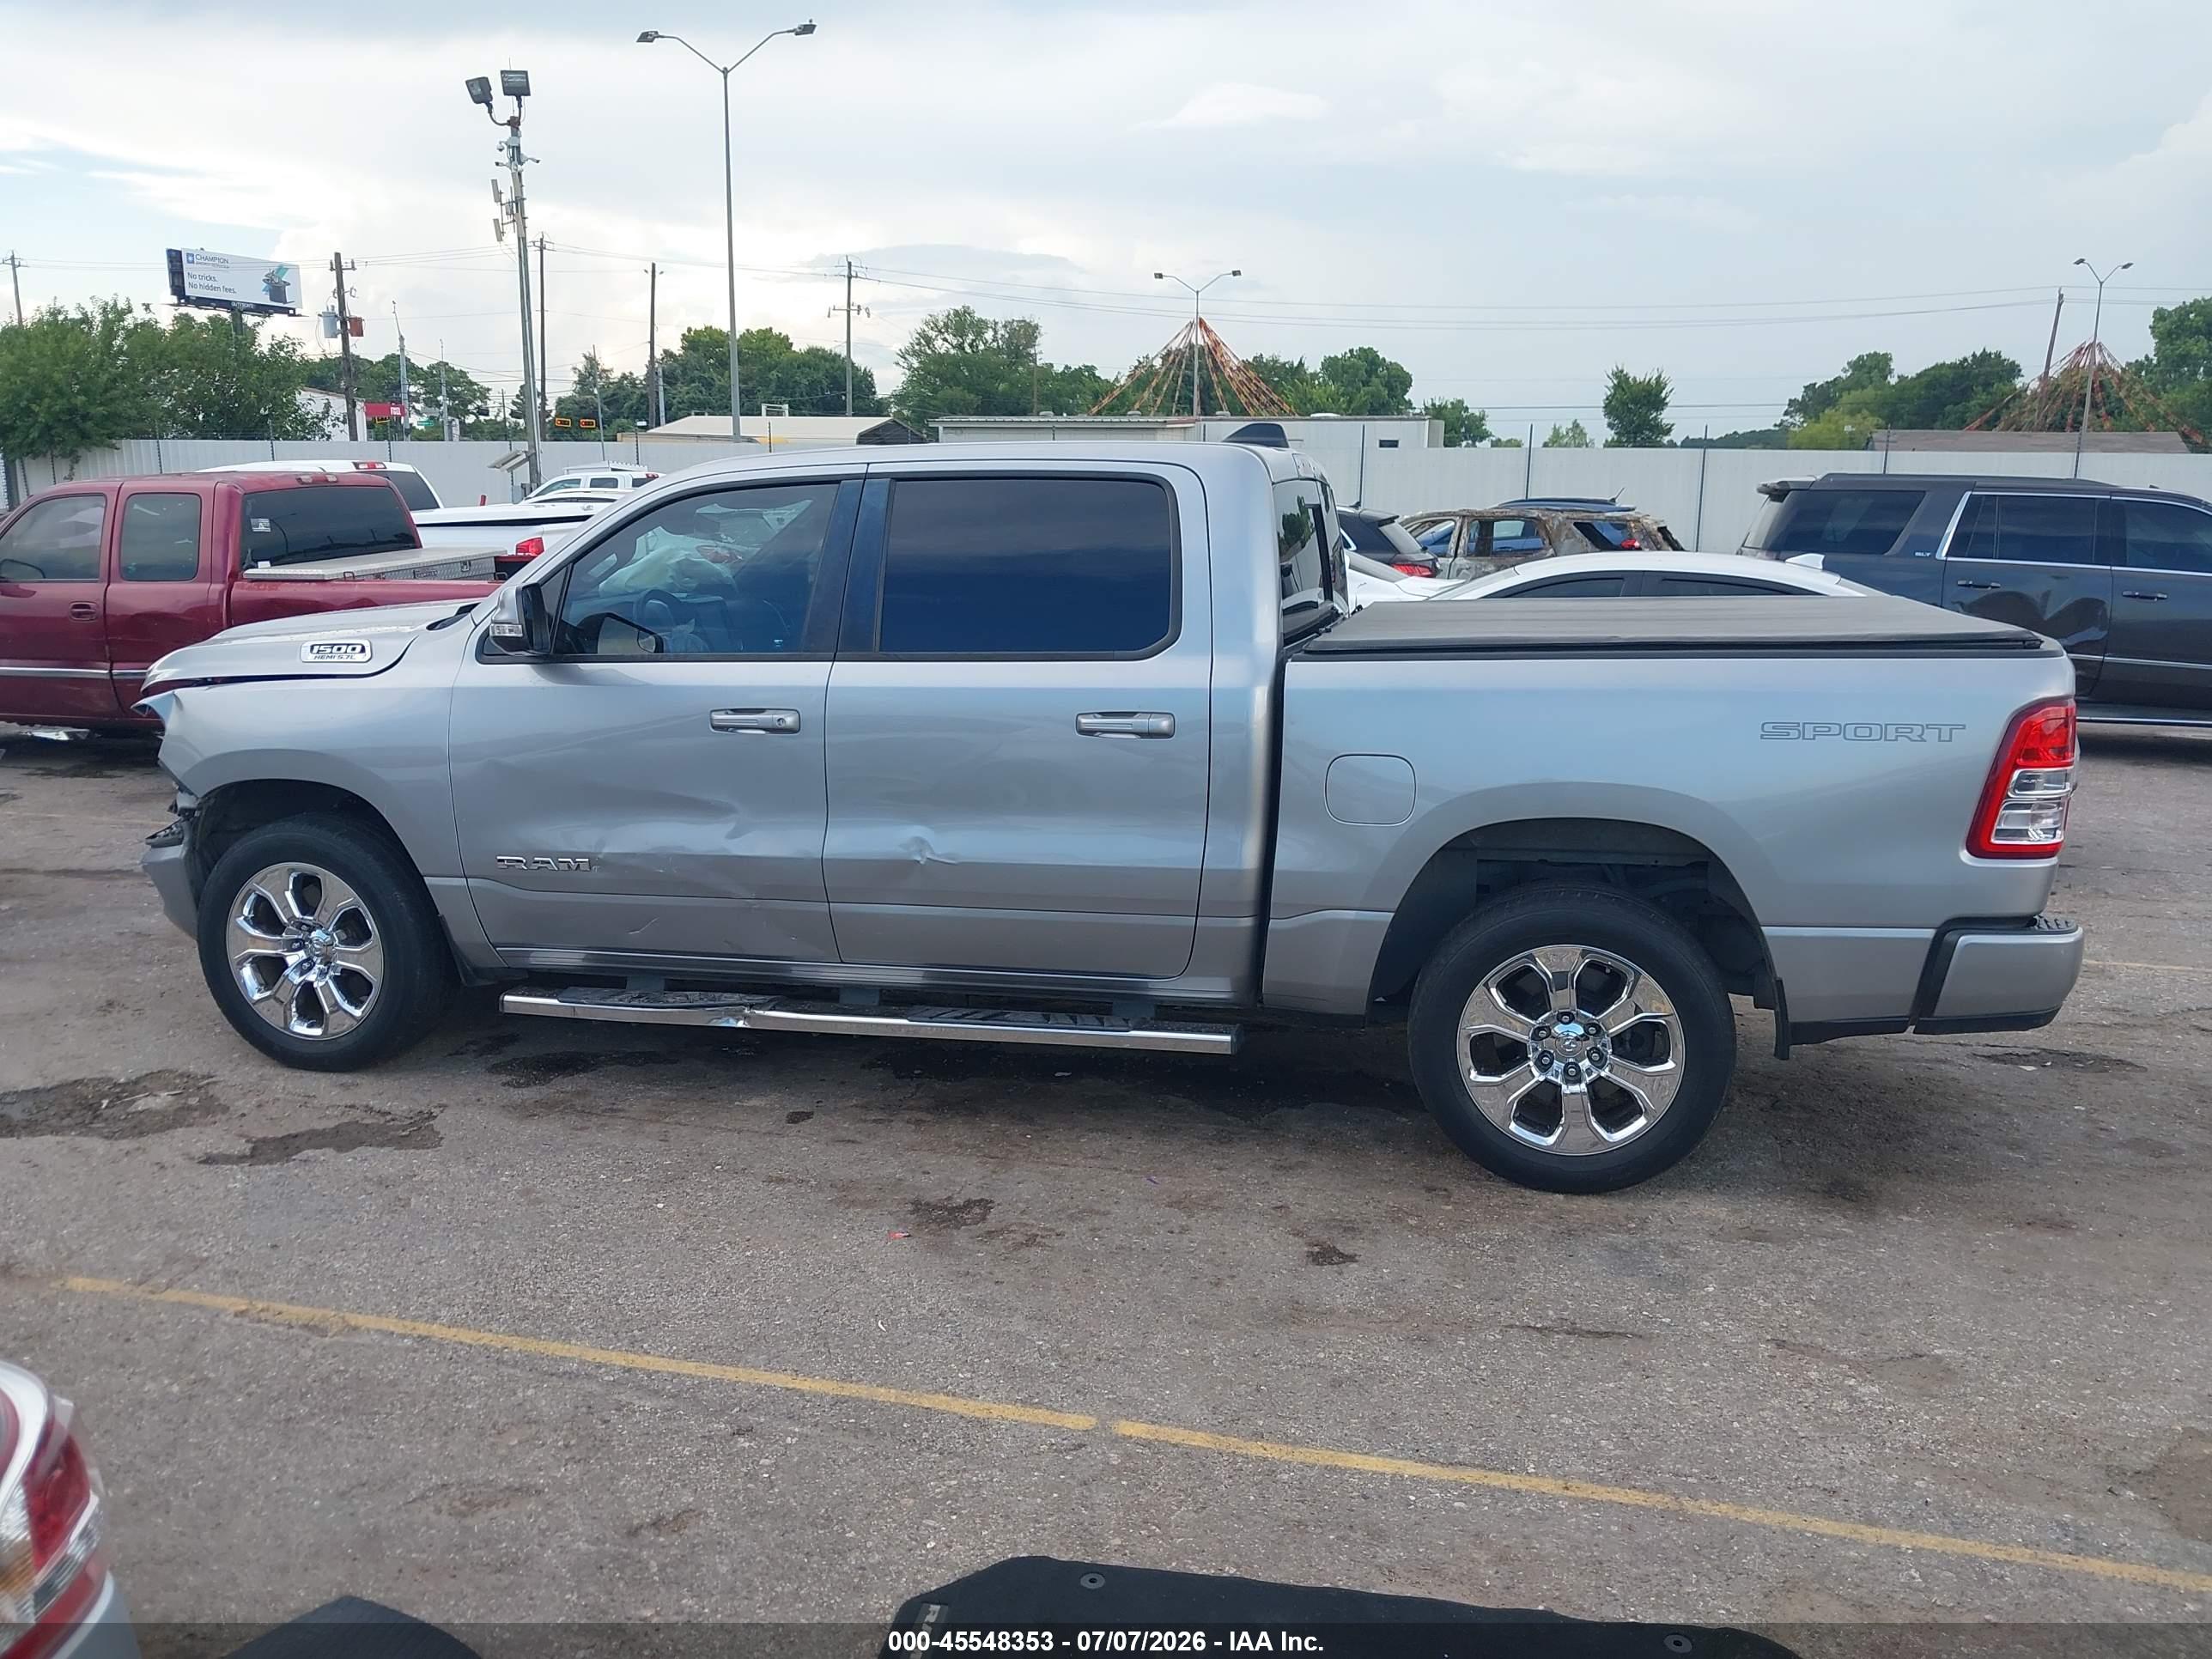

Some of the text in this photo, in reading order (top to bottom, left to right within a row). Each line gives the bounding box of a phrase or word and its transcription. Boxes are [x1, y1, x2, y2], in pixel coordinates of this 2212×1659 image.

[196, 253, 229, 264] CHAMPION
[198, 273, 218, 282] tricks.
[199, 283, 222, 292] hidden
[222, 285, 237, 294] fees.
[312, 644, 362, 653] 1500
[1759, 721, 1966, 743] SPORT
[495, 855, 592, 872] RAM
